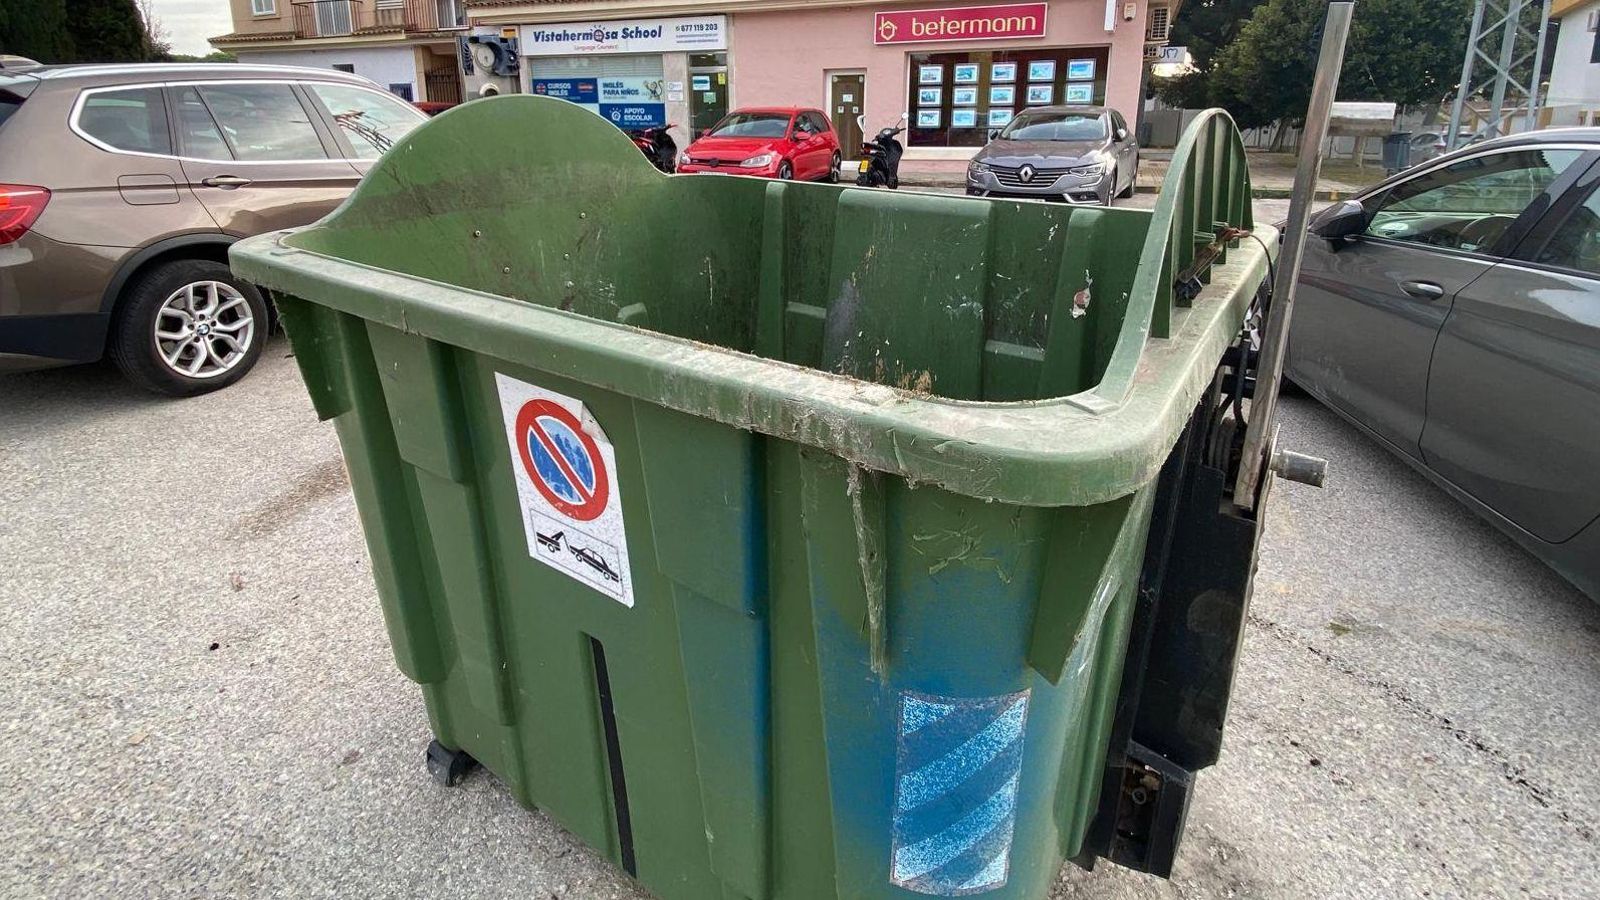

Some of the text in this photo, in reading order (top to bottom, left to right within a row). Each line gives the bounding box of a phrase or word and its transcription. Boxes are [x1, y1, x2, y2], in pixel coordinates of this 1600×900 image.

[705, 23, 718, 31] 203
[911, 15, 1036, 36] betermann
[533, 25, 662, 43] Vistahermosa School
[548, 88, 568, 96] INGLÉS
[620, 87, 640, 96] NIÑOS
